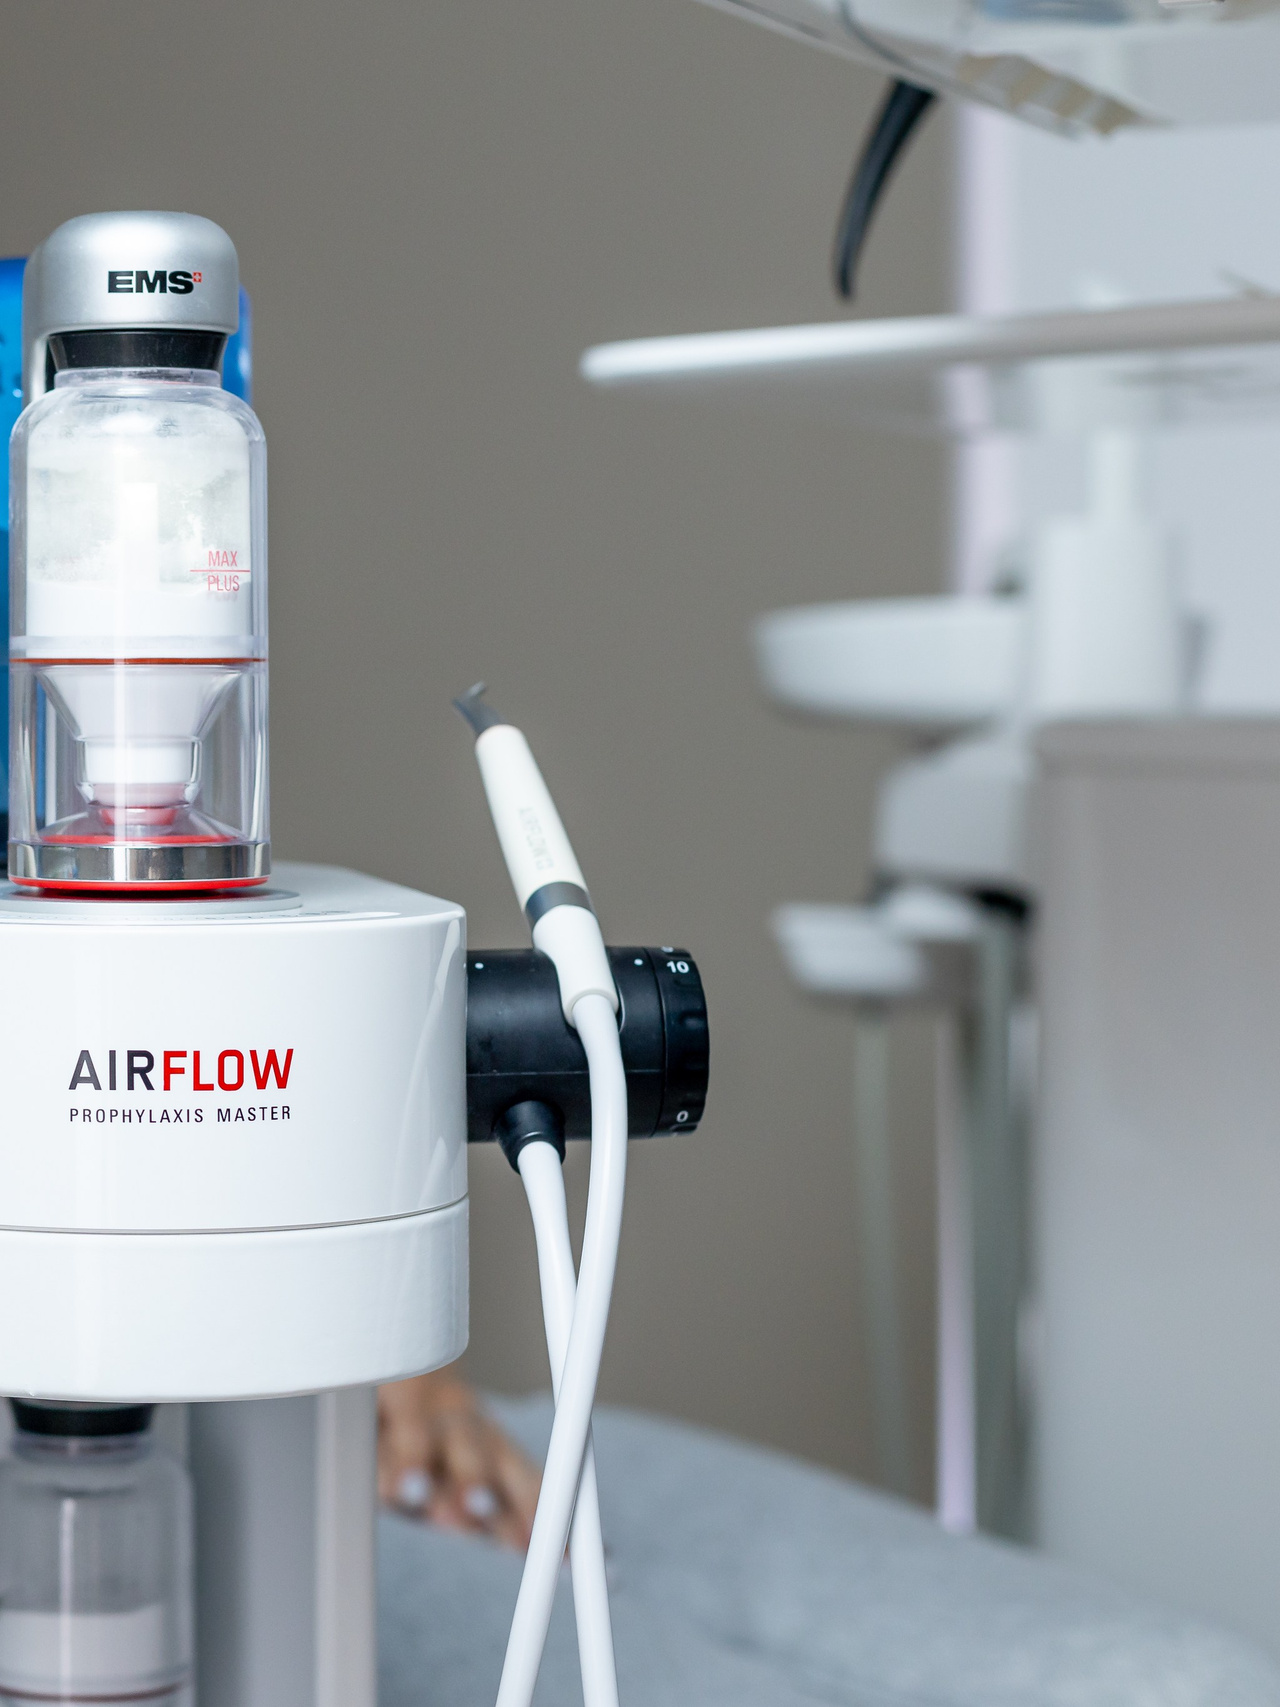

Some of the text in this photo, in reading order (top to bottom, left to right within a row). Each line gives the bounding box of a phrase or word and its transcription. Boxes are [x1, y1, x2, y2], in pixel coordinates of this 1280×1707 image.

[107, 270, 195, 295] EMS
[208, 550, 238, 567] MAX
[207, 574, 241, 592] PLUS
[666, 960, 690, 974] 10
[68, 1048, 295, 1092] AIRFLOW
[69, 1105, 291, 1124] PROPHYLAXIS MASTER
[676, 1110, 689, 1123] 0
